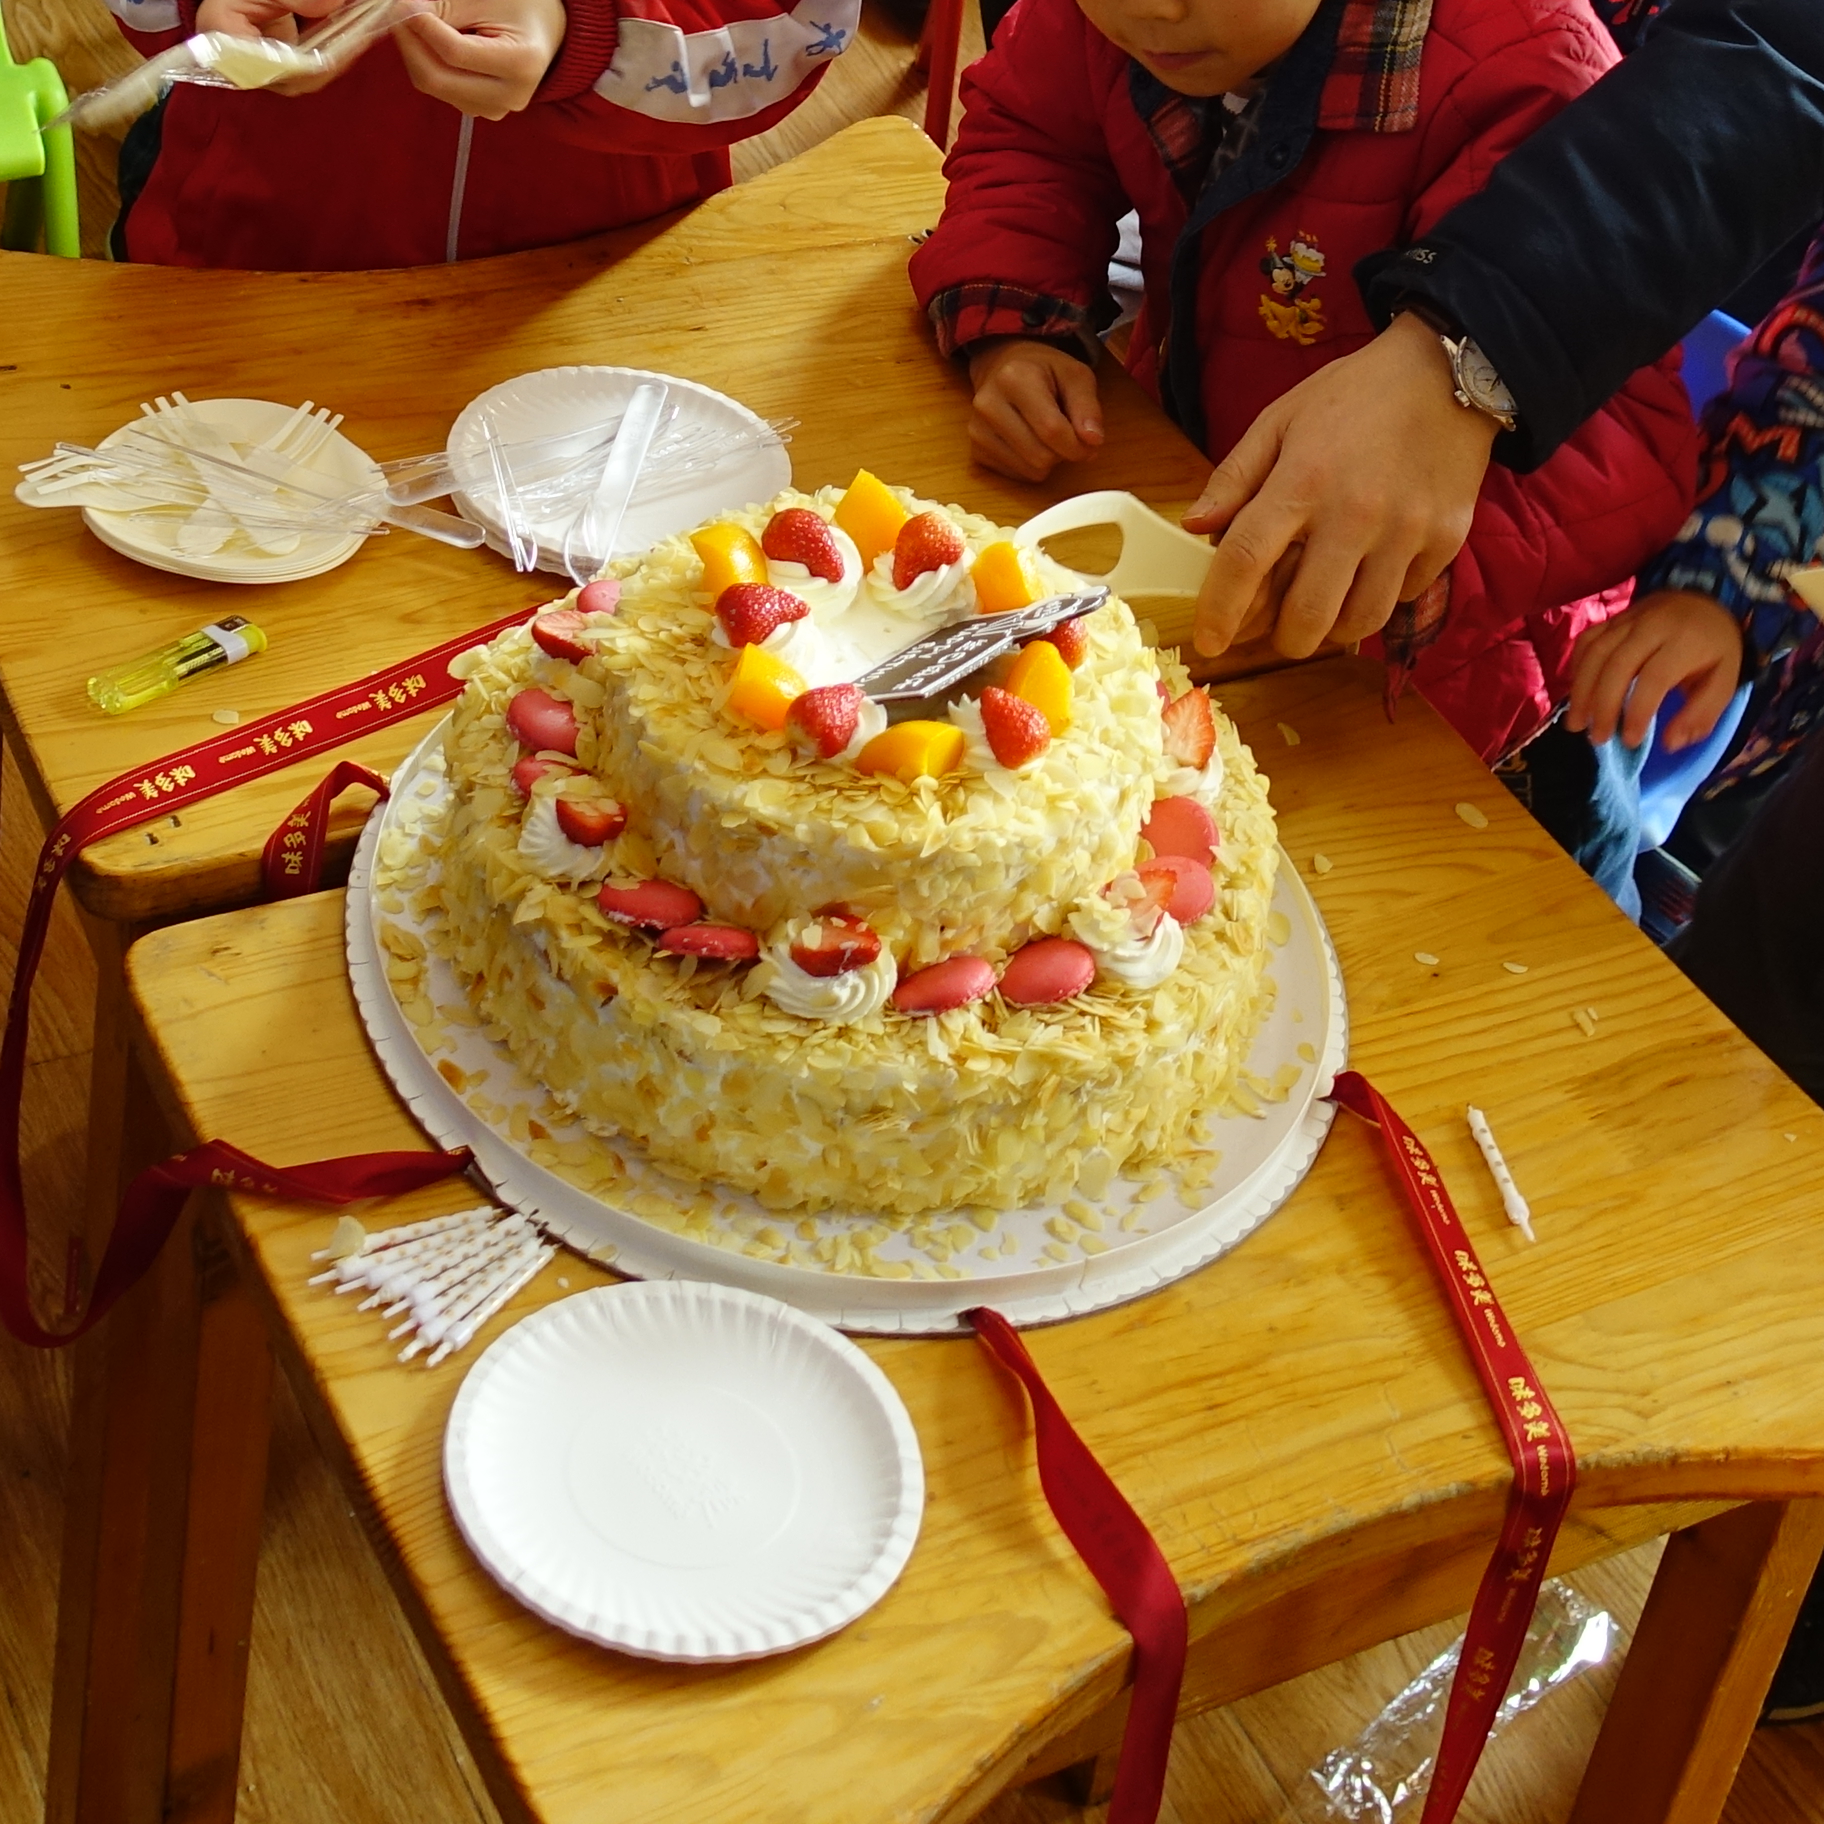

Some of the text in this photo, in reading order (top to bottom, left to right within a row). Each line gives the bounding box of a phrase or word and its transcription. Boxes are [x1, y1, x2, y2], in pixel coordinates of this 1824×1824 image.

[853, 641, 936, 687] BIRTHD
[369, 674, 427, 711] 味多美
[253, 720, 313, 755] 味多美
[133, 765, 196, 800] 味多美
[281, 811, 311, 874] 味多美
[1454, 1250, 1494, 1305] 味多美
[1508, 1377, 1551, 1442] 味多美
